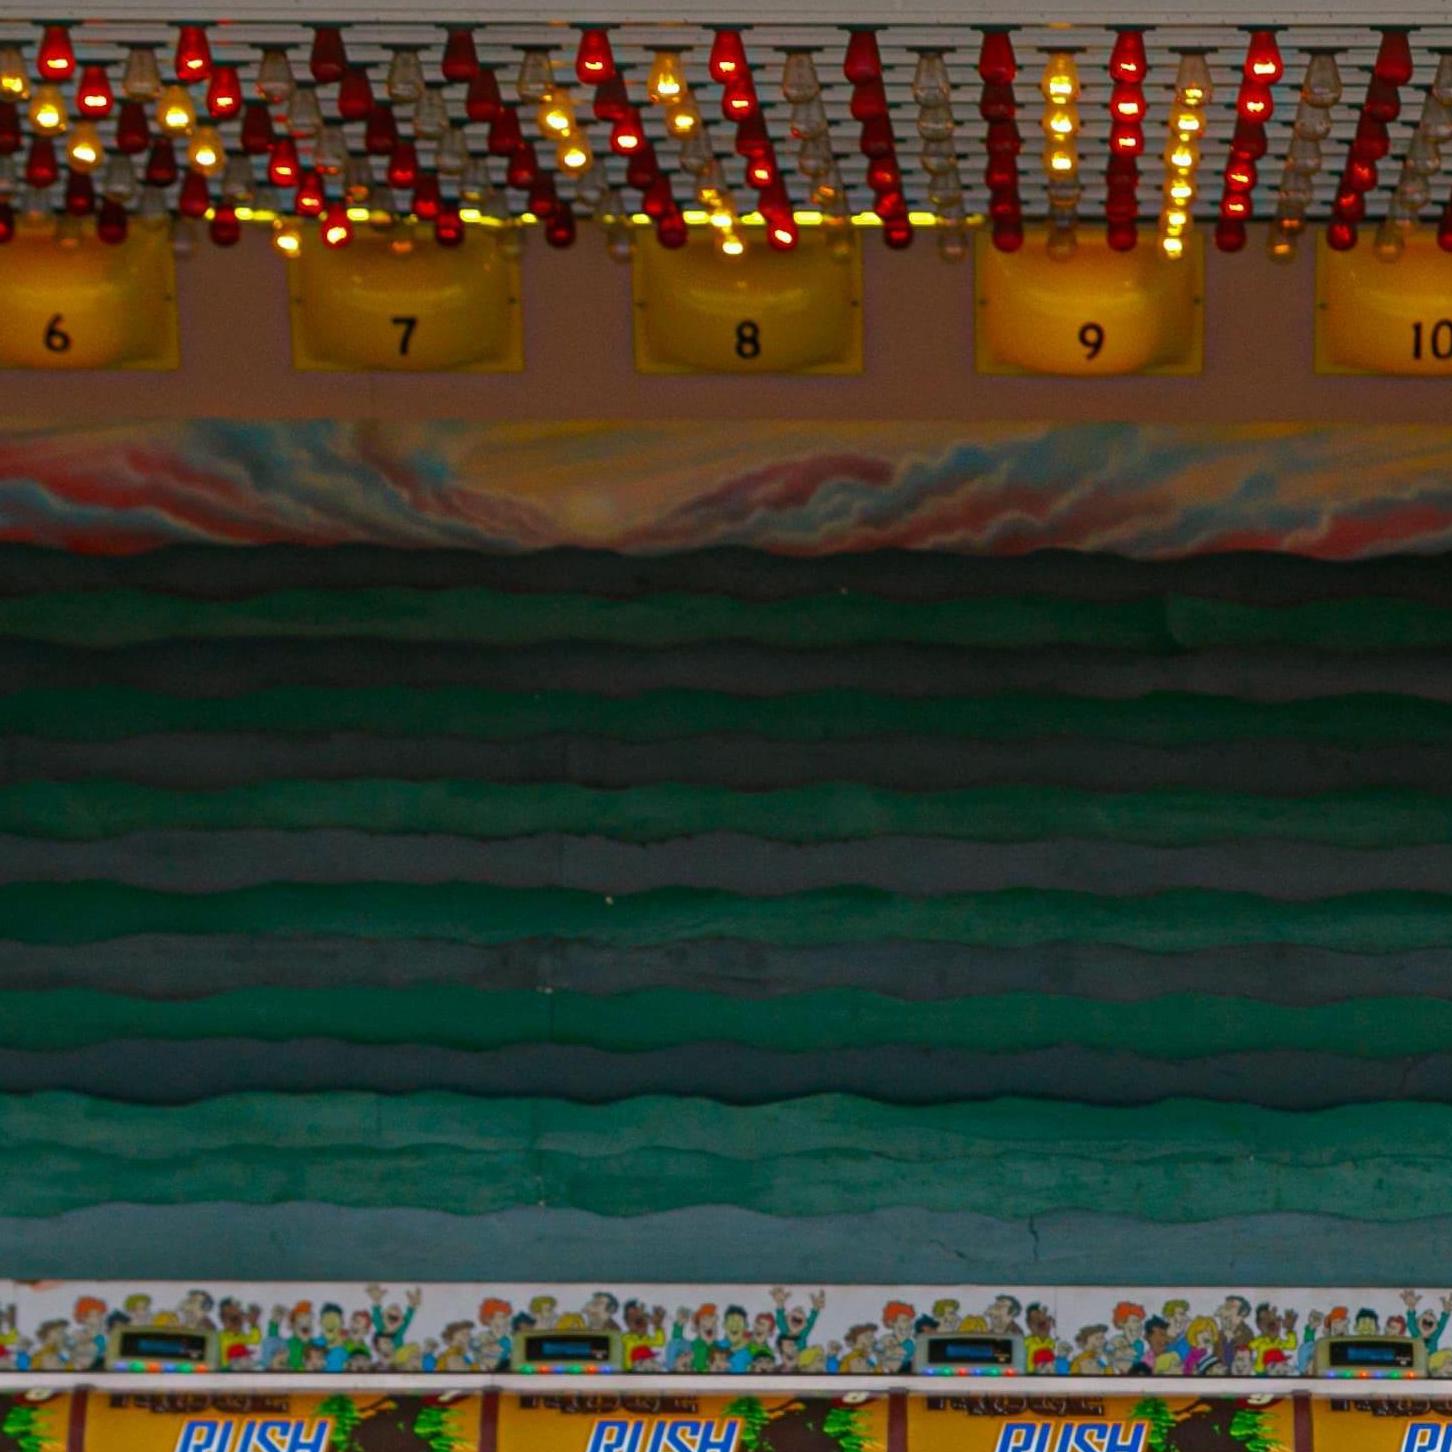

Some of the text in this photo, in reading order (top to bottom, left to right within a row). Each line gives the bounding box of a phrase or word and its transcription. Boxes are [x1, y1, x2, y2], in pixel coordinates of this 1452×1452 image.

[43, 313, 71, 354] 6
[390, 316, 418, 357] 7
[734, 319, 762, 360] 8
[1077, 321, 1106, 361] 9
